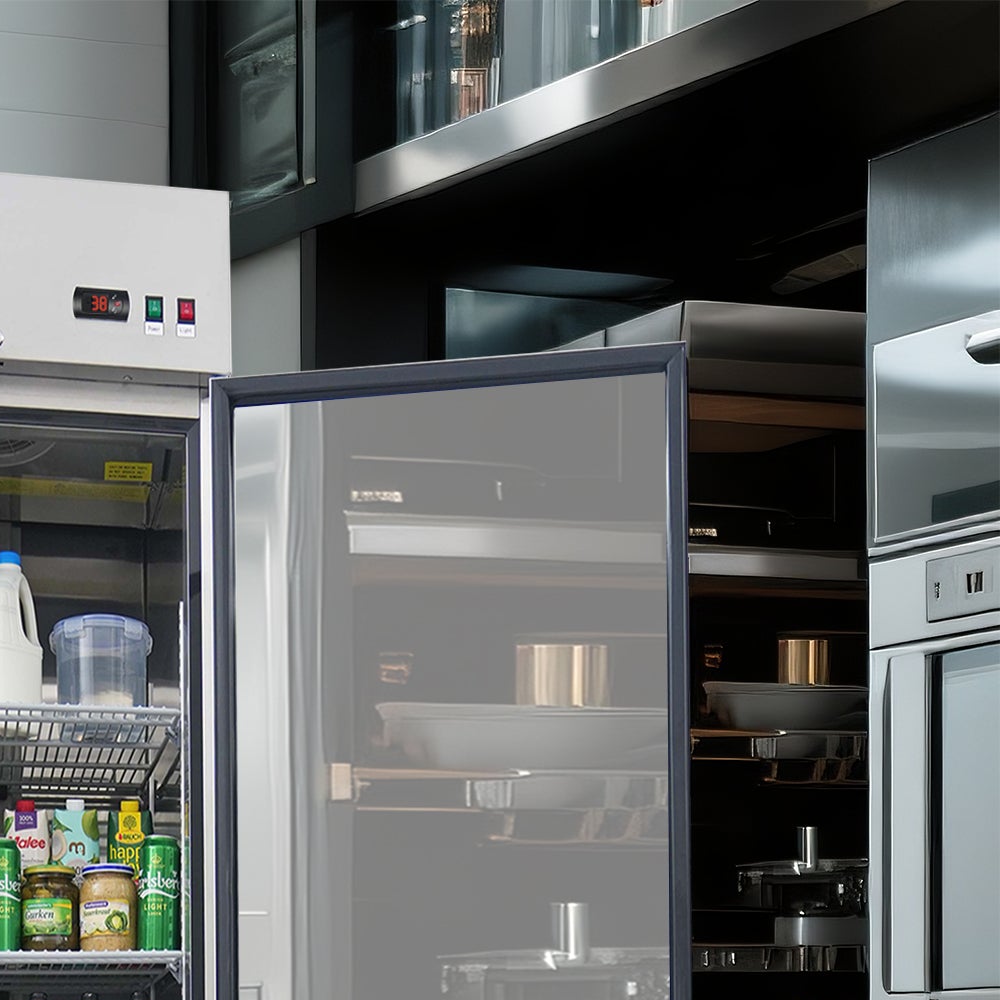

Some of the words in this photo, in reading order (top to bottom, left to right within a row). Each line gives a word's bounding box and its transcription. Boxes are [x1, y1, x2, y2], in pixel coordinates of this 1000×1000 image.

[91, 295, 108, 312] 38
[122, 833, 142, 841] RAUCH
[143, 903, 168, 912] LIGHT
[25, 909, 55, 922] Gurken
